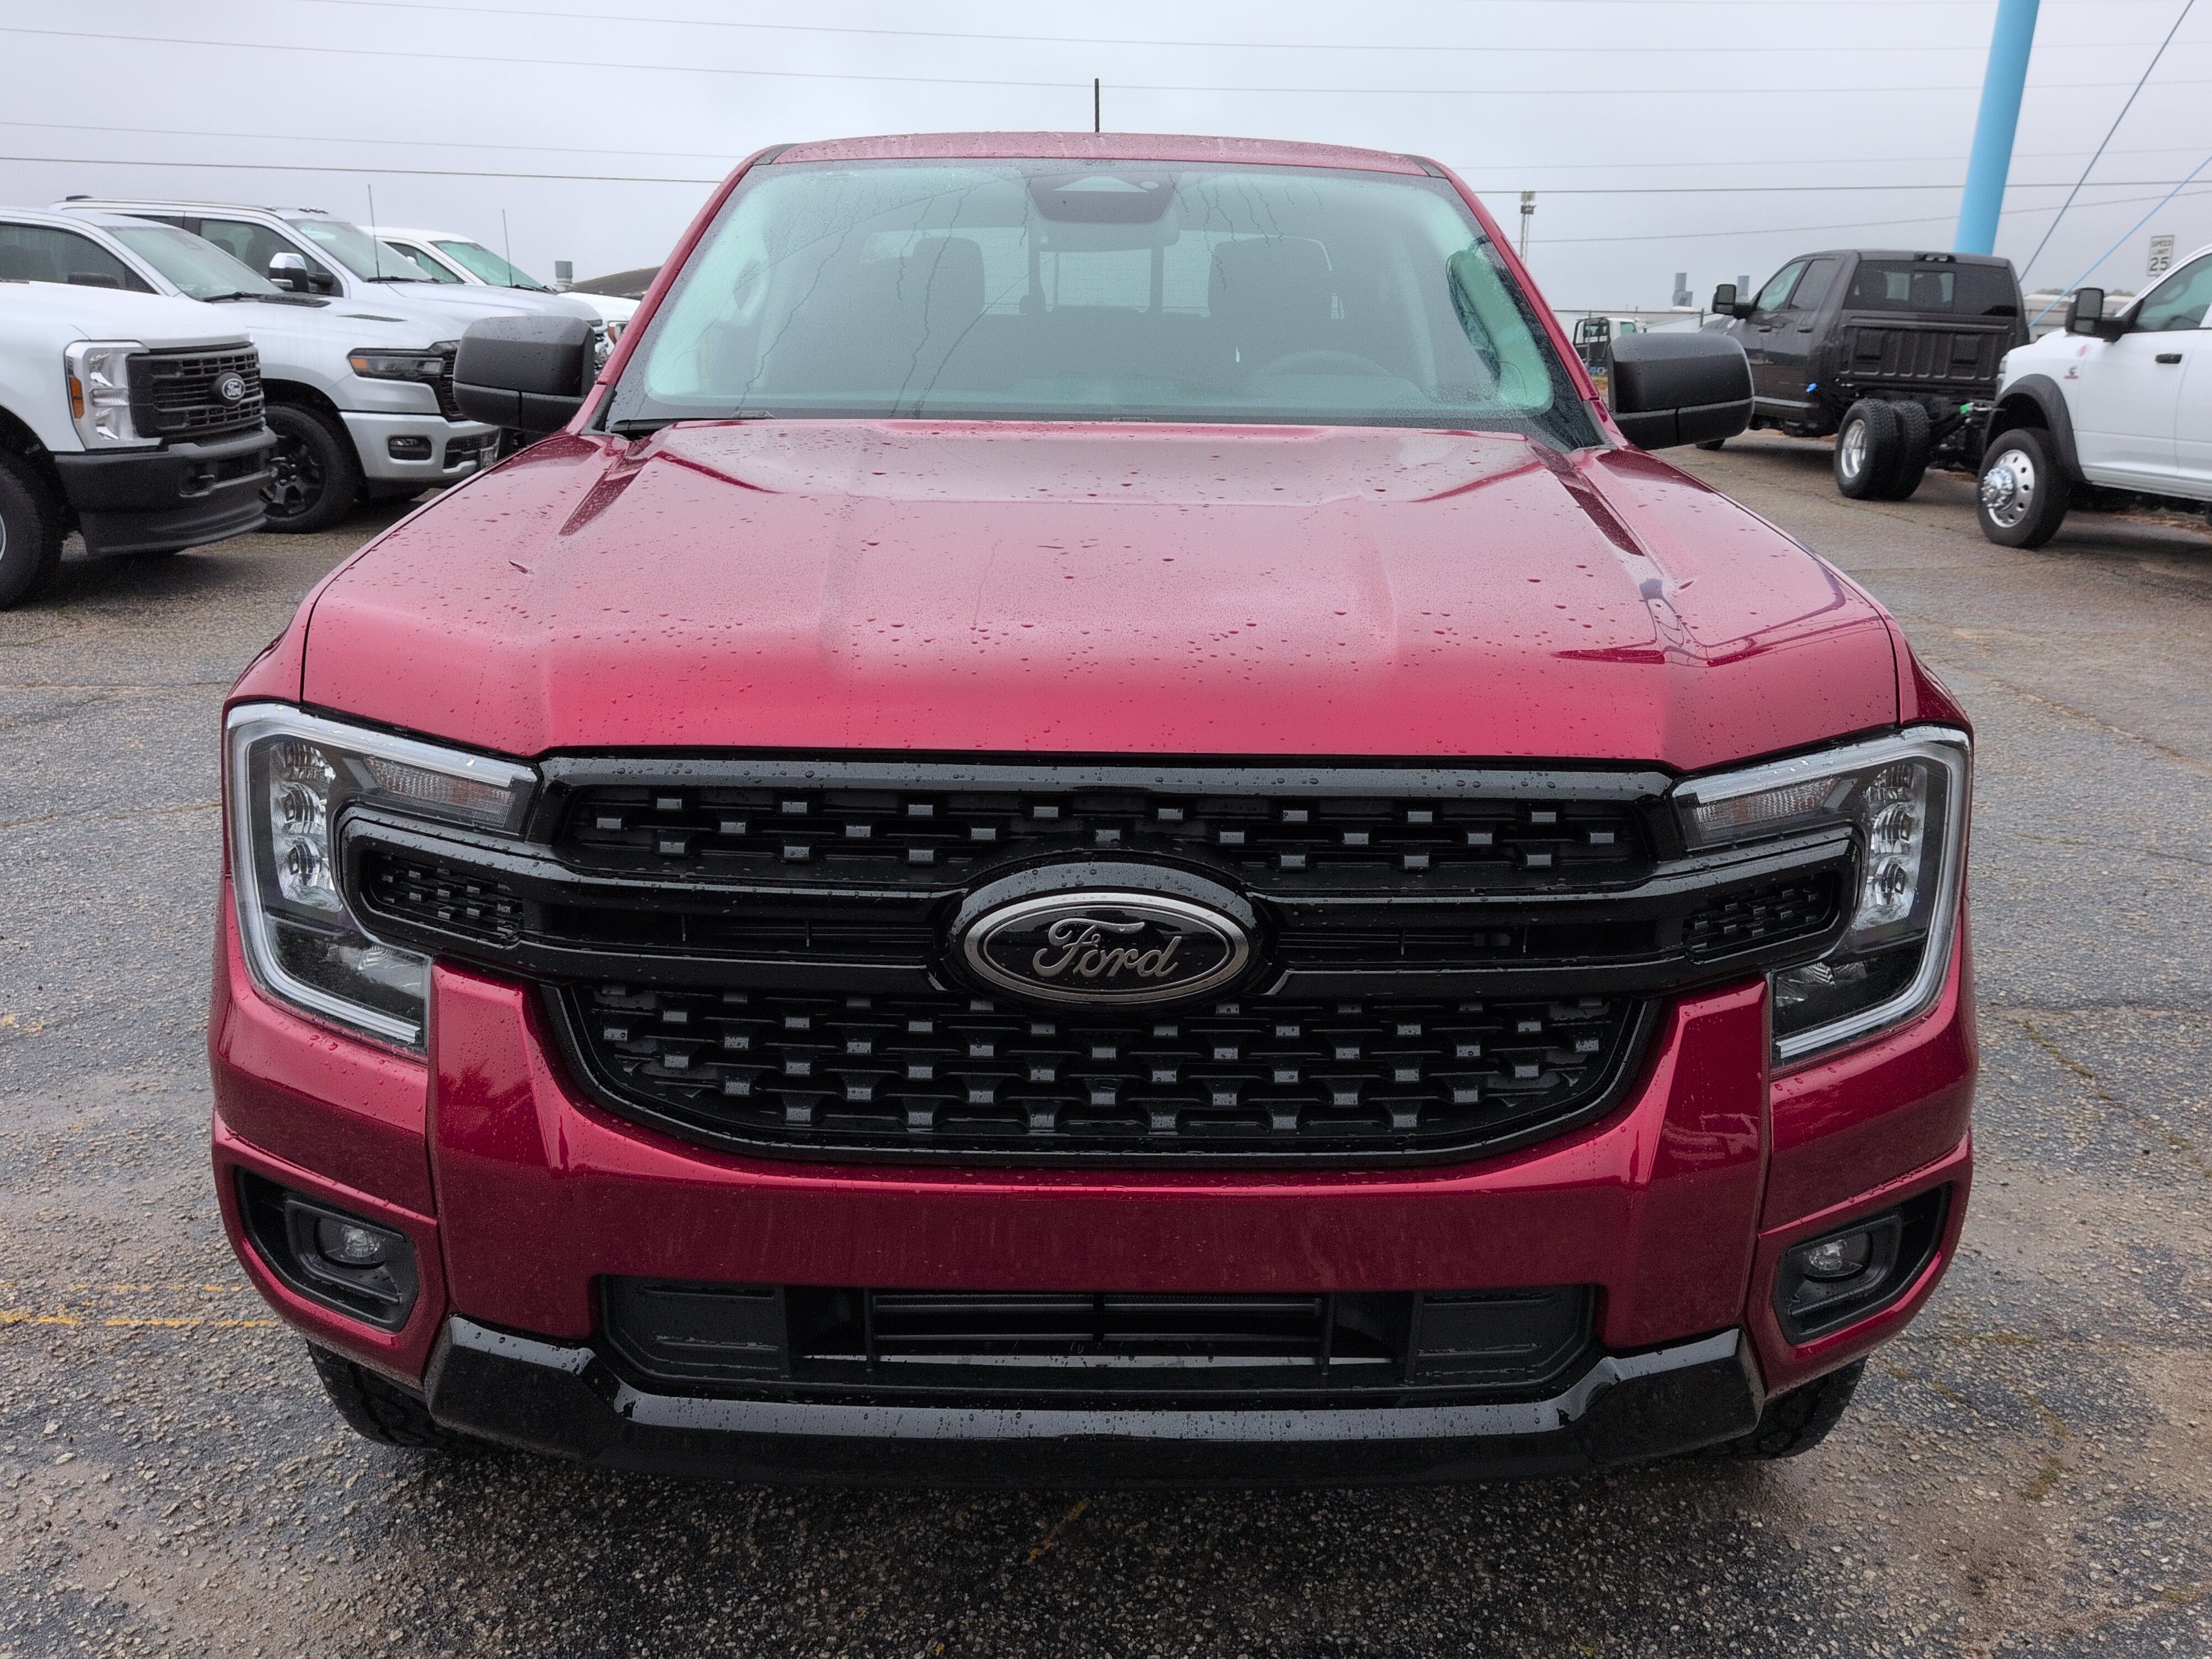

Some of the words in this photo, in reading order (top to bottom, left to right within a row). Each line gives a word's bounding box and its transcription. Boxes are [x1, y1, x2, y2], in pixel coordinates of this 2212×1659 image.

[2149, 257, 2169, 271] 25
[227, 381, 242, 397] Ford
[1032, 918, 1182, 978] Ford
